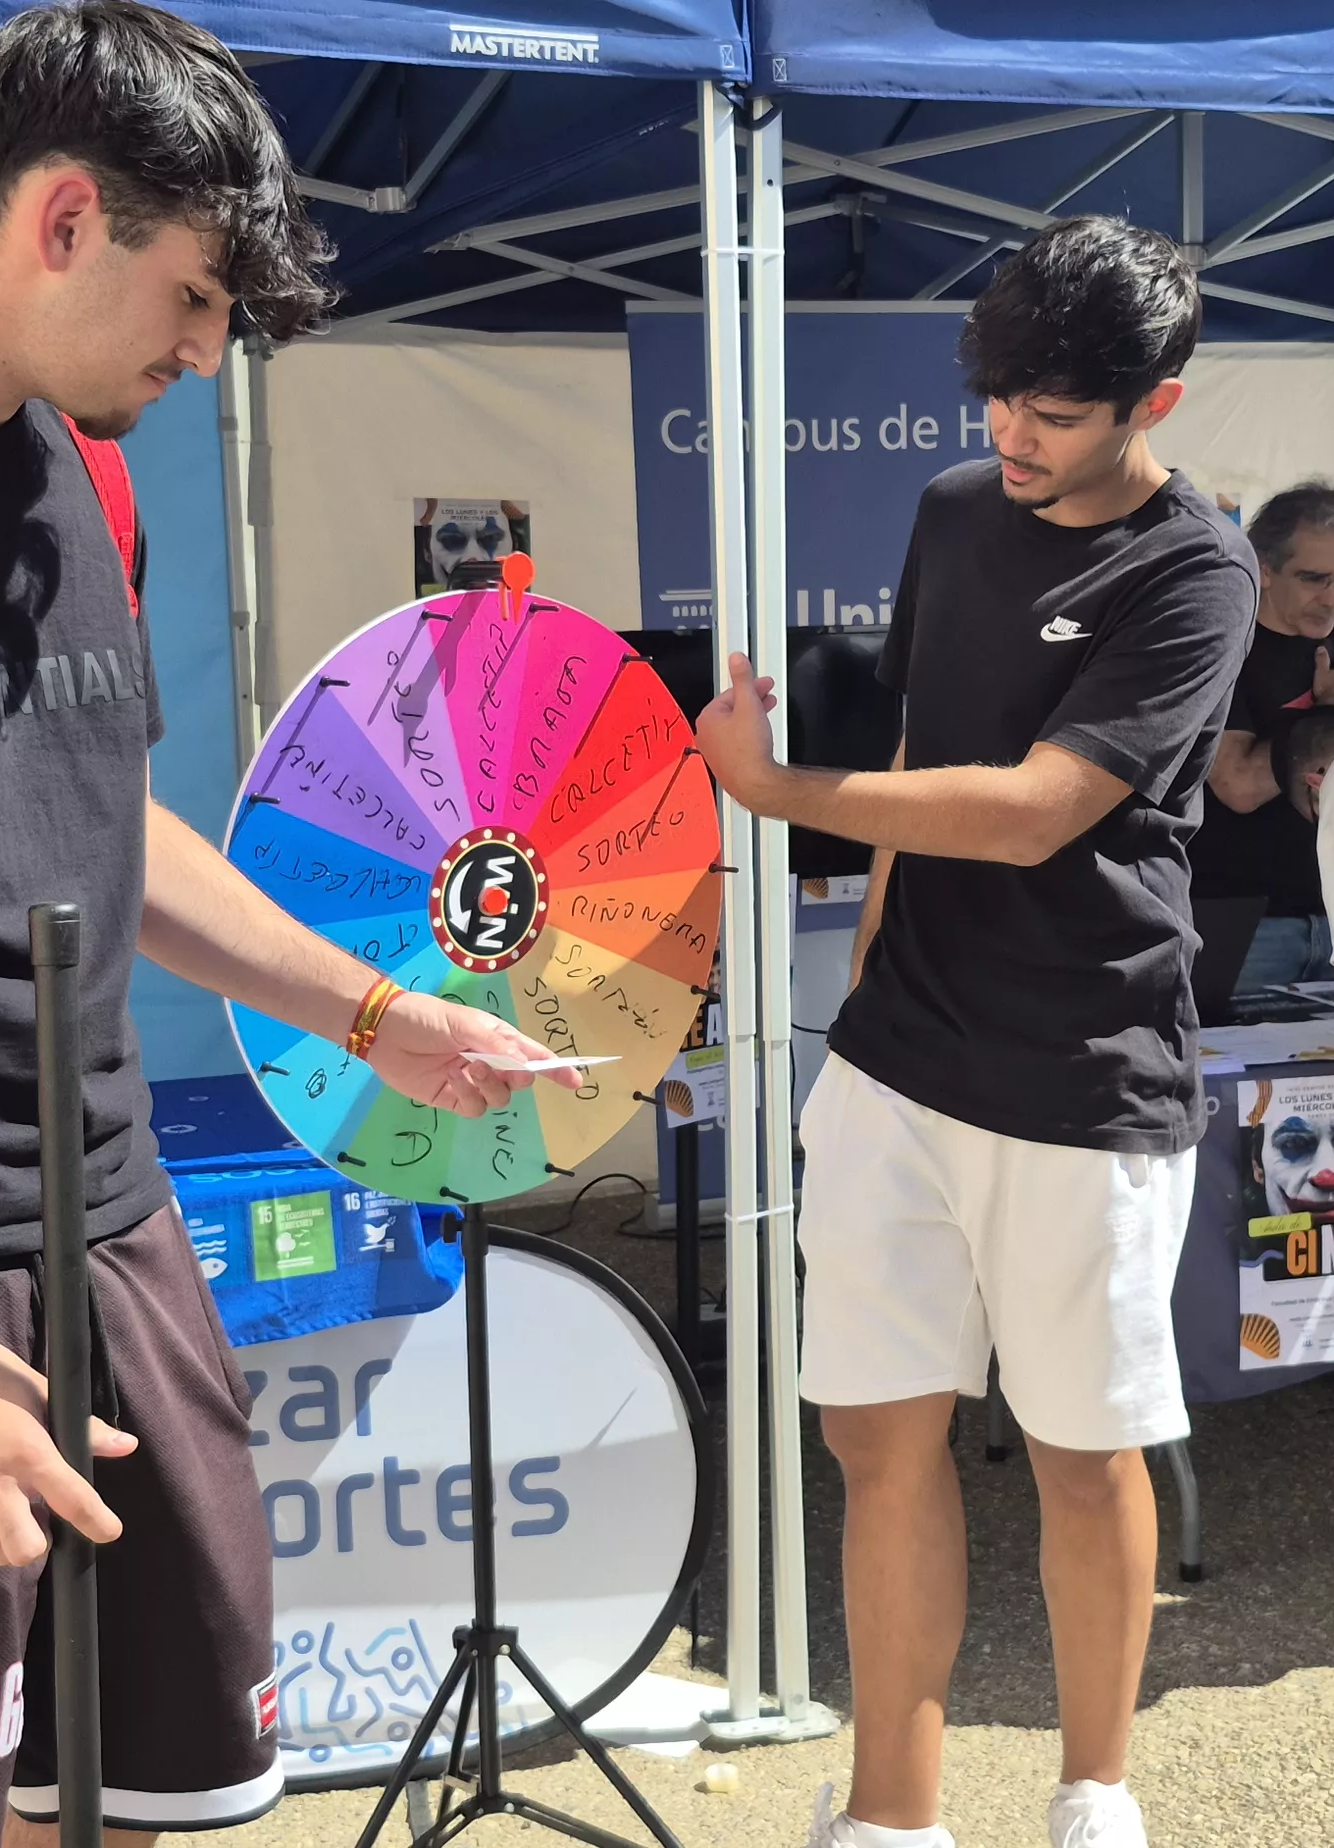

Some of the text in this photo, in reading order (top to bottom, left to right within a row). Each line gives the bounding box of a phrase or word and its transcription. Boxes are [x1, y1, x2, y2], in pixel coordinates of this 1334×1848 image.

[878, 403, 939, 450] de
[1050, 615, 1083, 637] NIKE
[1279, 1095, 1299, 1105] LOS
[1301, 1092, 1333, 1103] LUNES
[344, 1192, 361, 1211] 16
